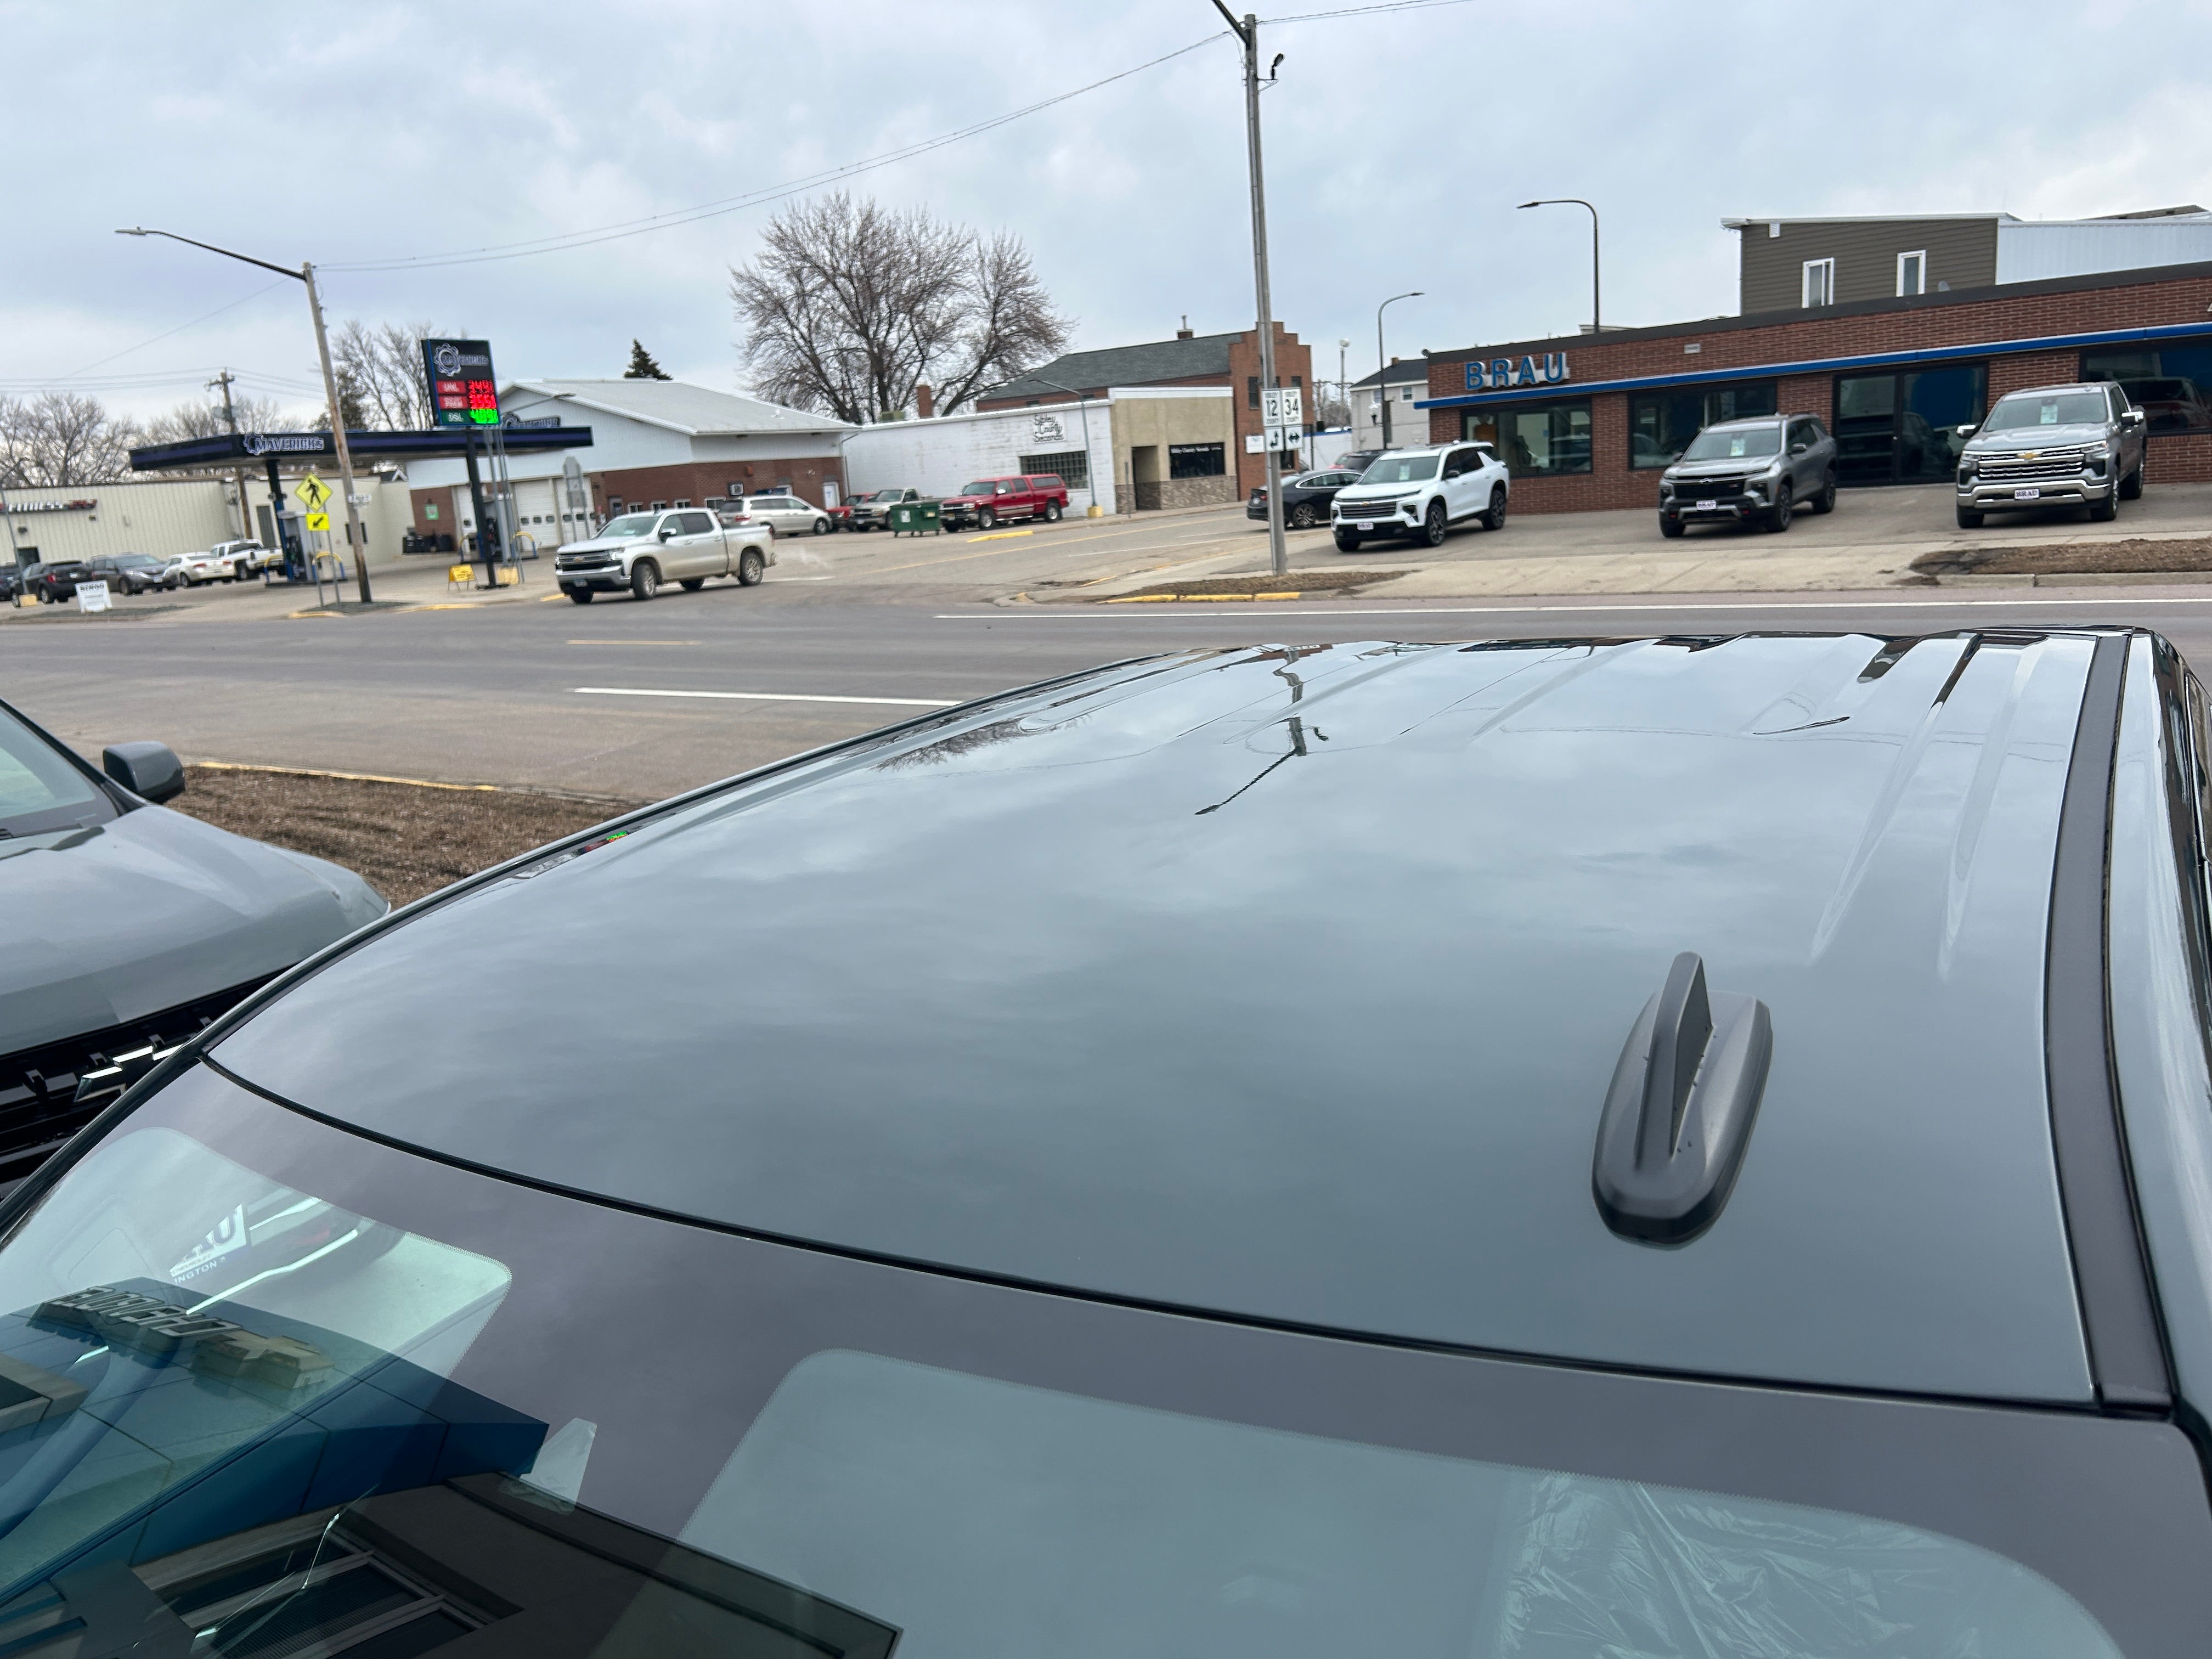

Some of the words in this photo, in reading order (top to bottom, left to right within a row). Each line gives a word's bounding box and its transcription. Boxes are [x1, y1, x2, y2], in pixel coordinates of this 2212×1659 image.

[1465, 353, 1566, 390] BRAU
[1266, 399, 1278, 416] 12
[1285, 398, 1299, 415] 34
[1034, 414, 1056, 426] Sibley
